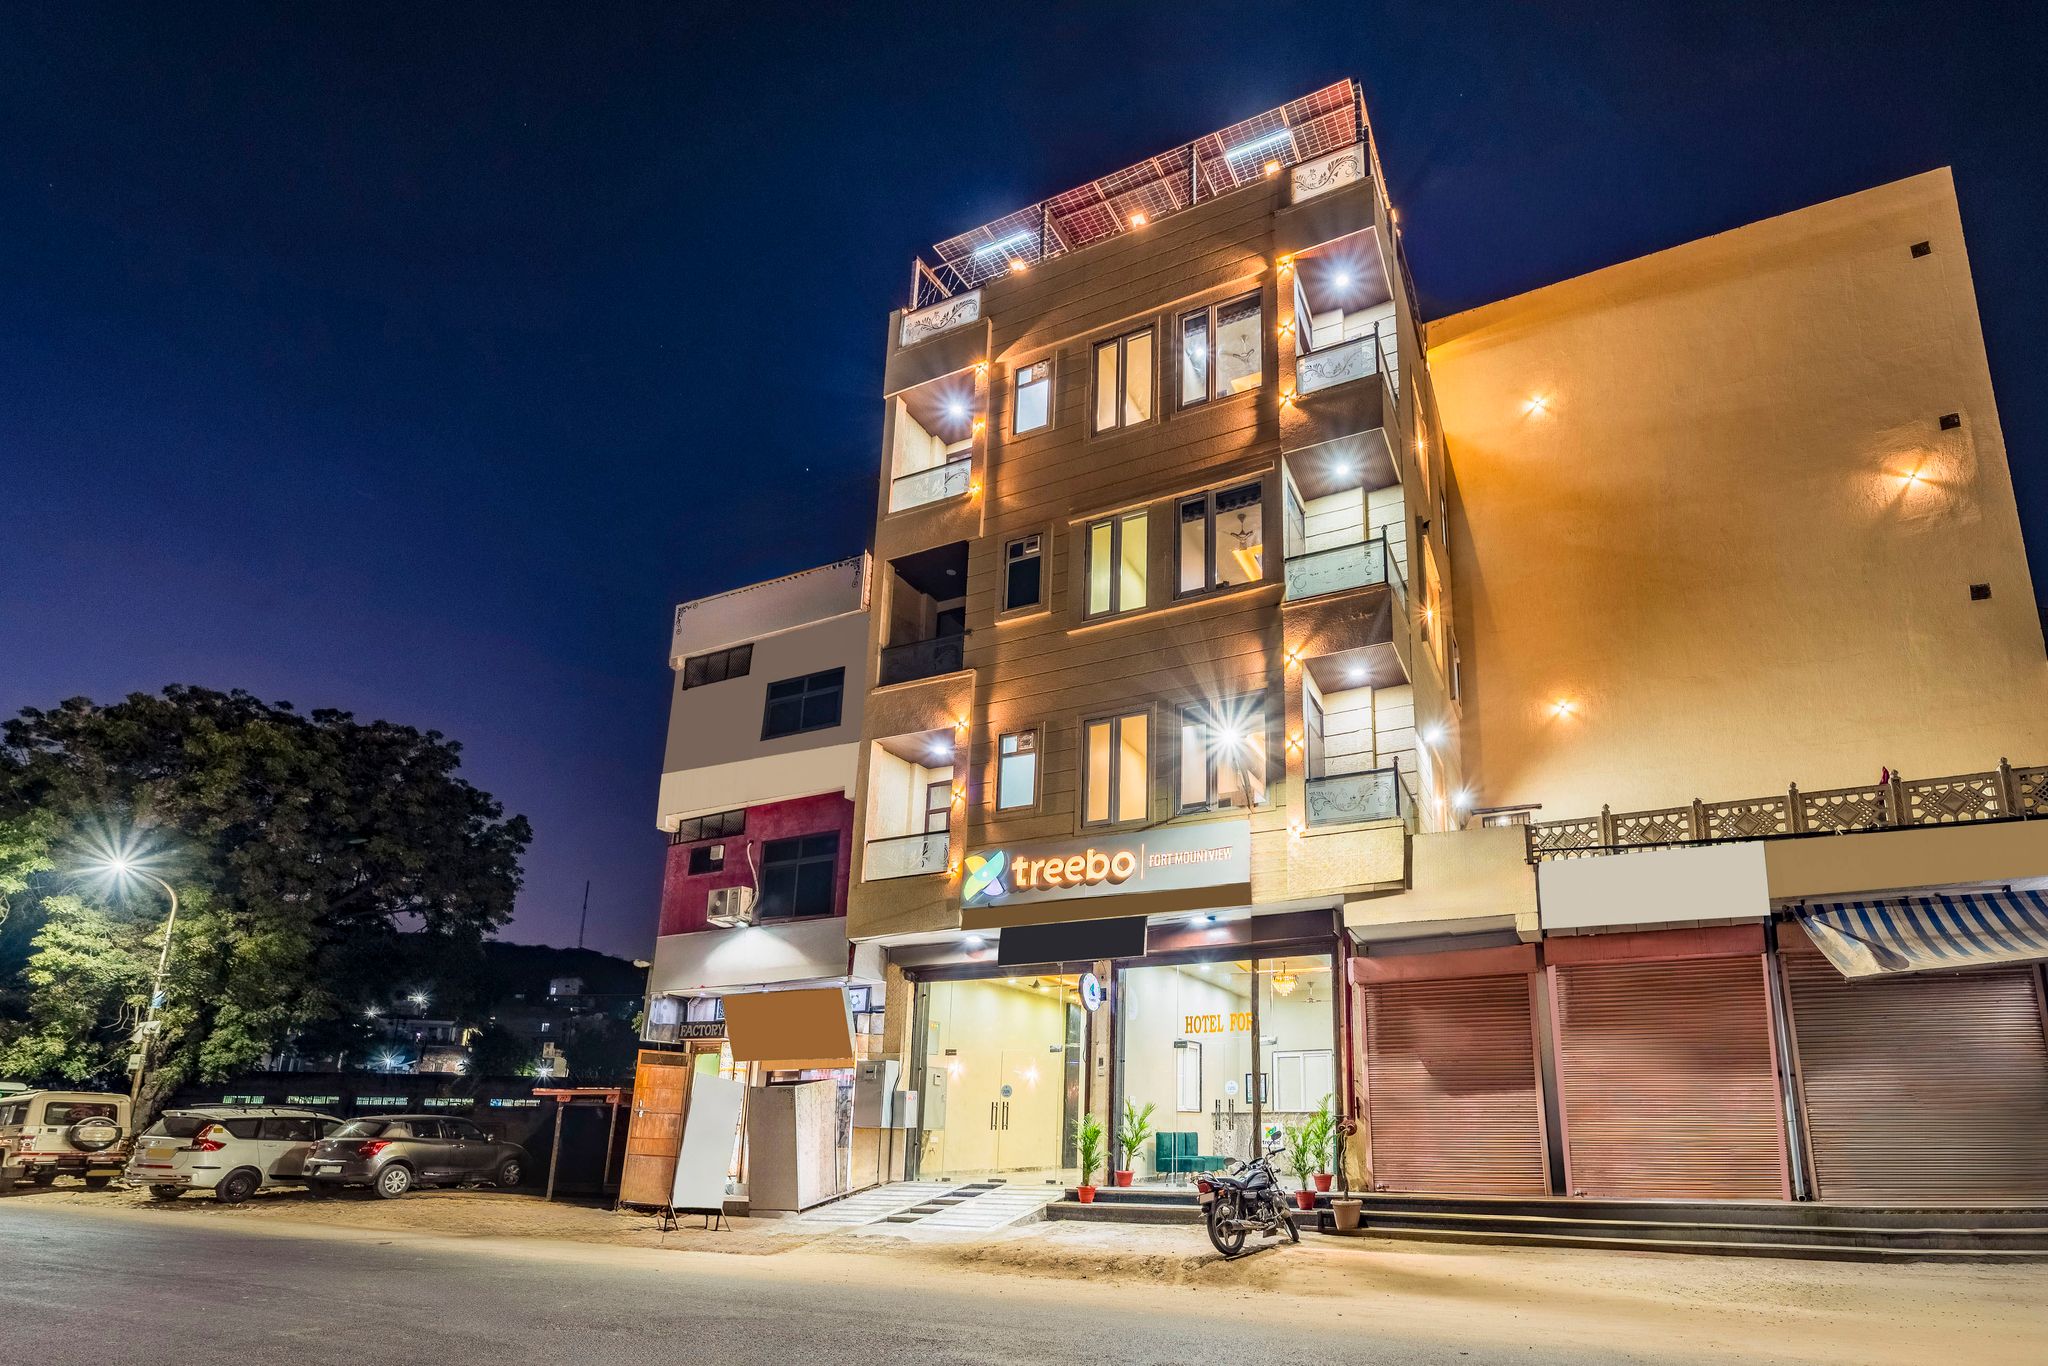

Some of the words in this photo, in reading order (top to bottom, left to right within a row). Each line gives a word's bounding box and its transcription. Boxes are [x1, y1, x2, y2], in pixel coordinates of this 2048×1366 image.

[1011, 848, 1136, 886] treebo
[1149, 854, 1172, 868] FORT
[680, 1024, 725, 1037] FACTORY
[1185, 1015, 1224, 1034] HOTEL
